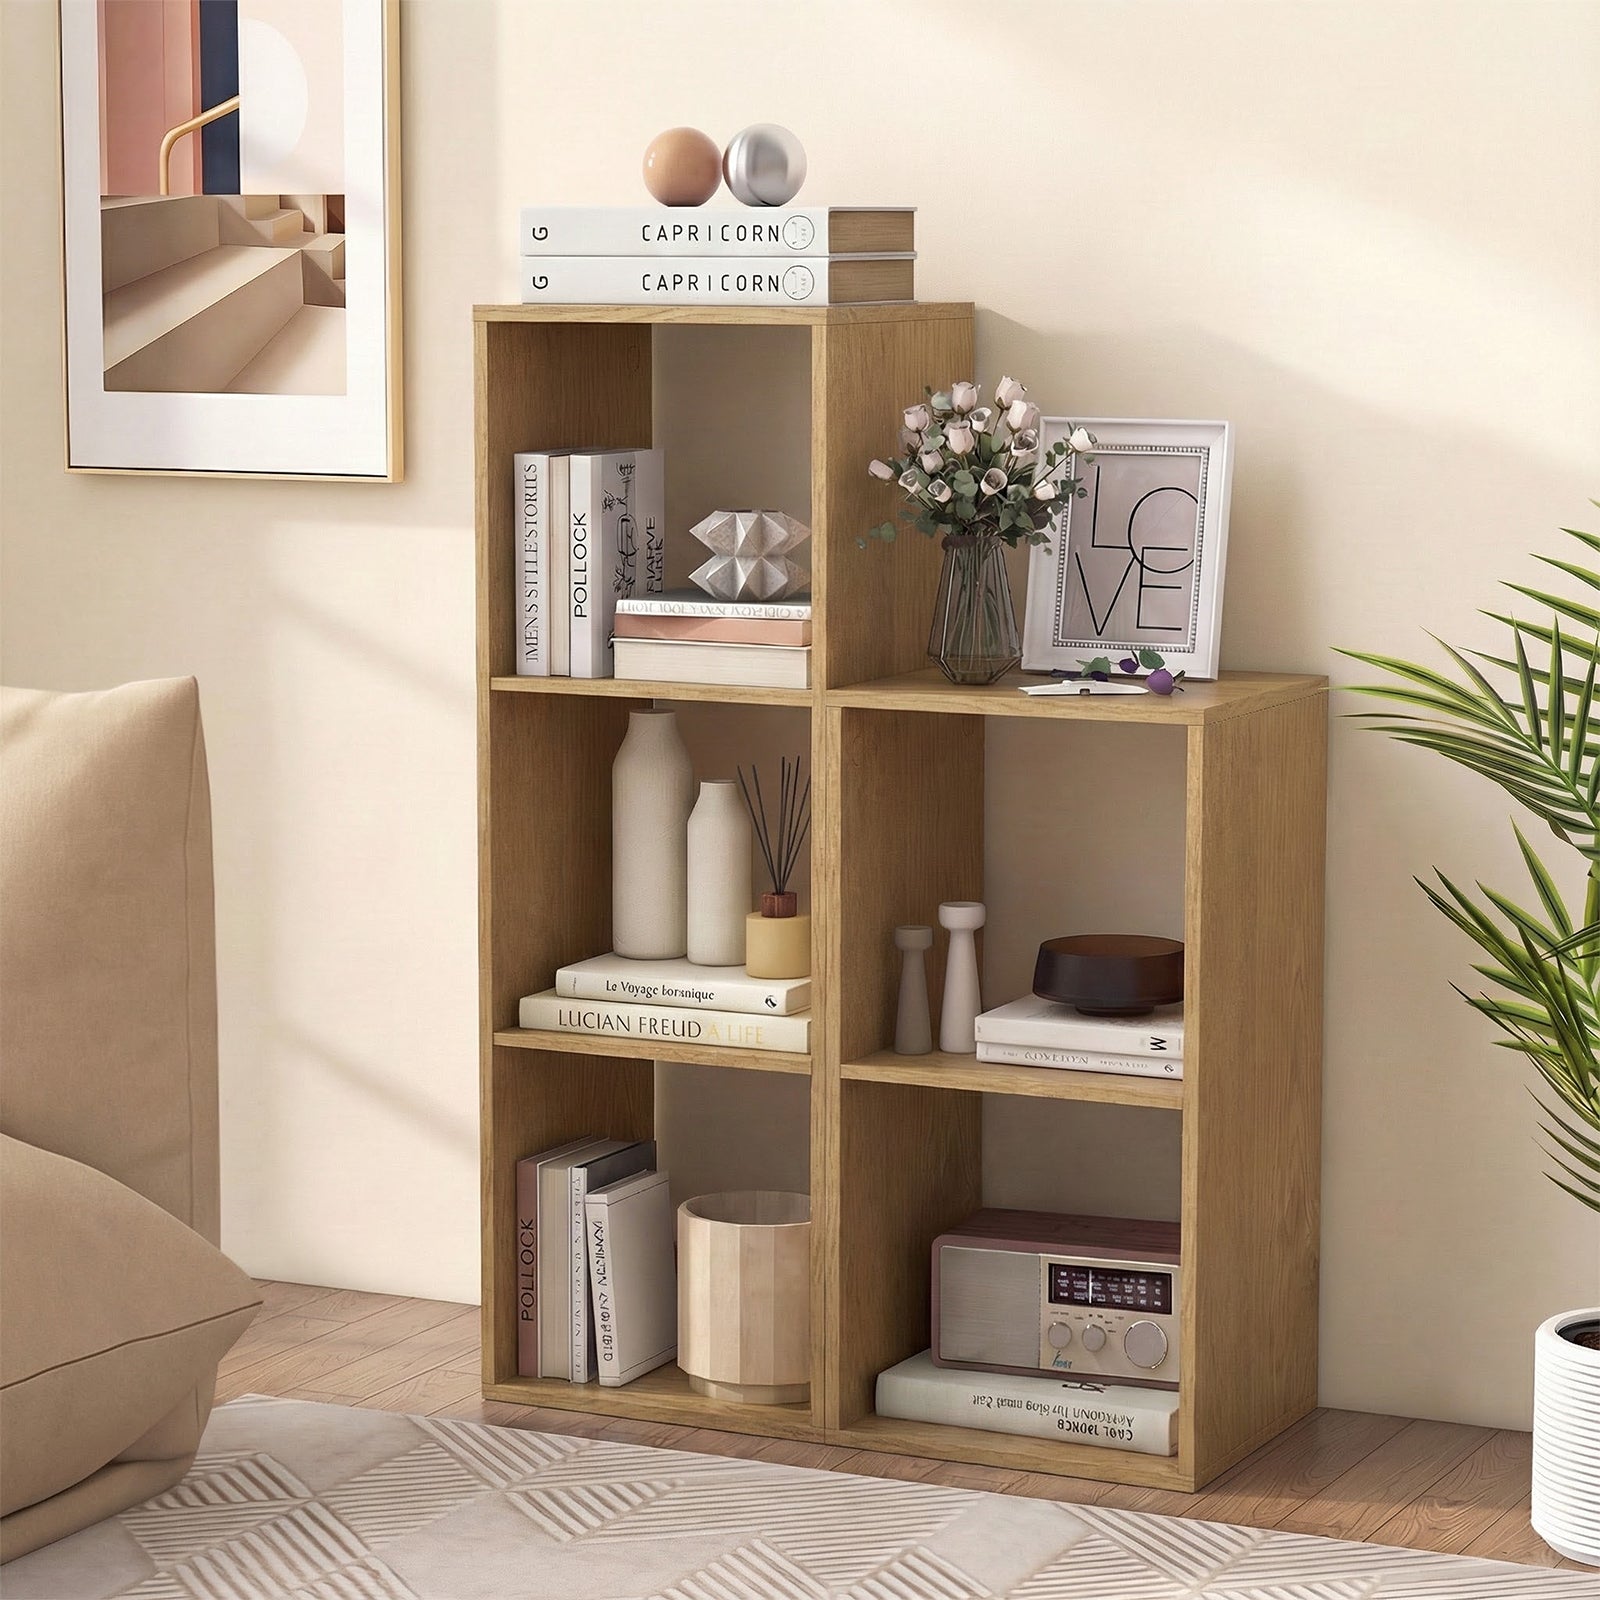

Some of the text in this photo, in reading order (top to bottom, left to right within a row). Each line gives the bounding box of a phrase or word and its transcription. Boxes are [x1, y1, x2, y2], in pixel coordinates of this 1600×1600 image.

[532, 226, 548, 241] G
[642, 224, 780, 243] CAPRICORN
[532, 275, 548, 290] G
[642, 273, 780, 292] CAPRICORN
[573, 513, 588, 618] POLLOCK
[606, 980, 617, 992] Le
[621, 981, 659, 999] Voyage
[558, 1009, 765, 1044] LUCIAN FREUD A LIFE
[520, 1218, 535, 1322] POLLOCK
